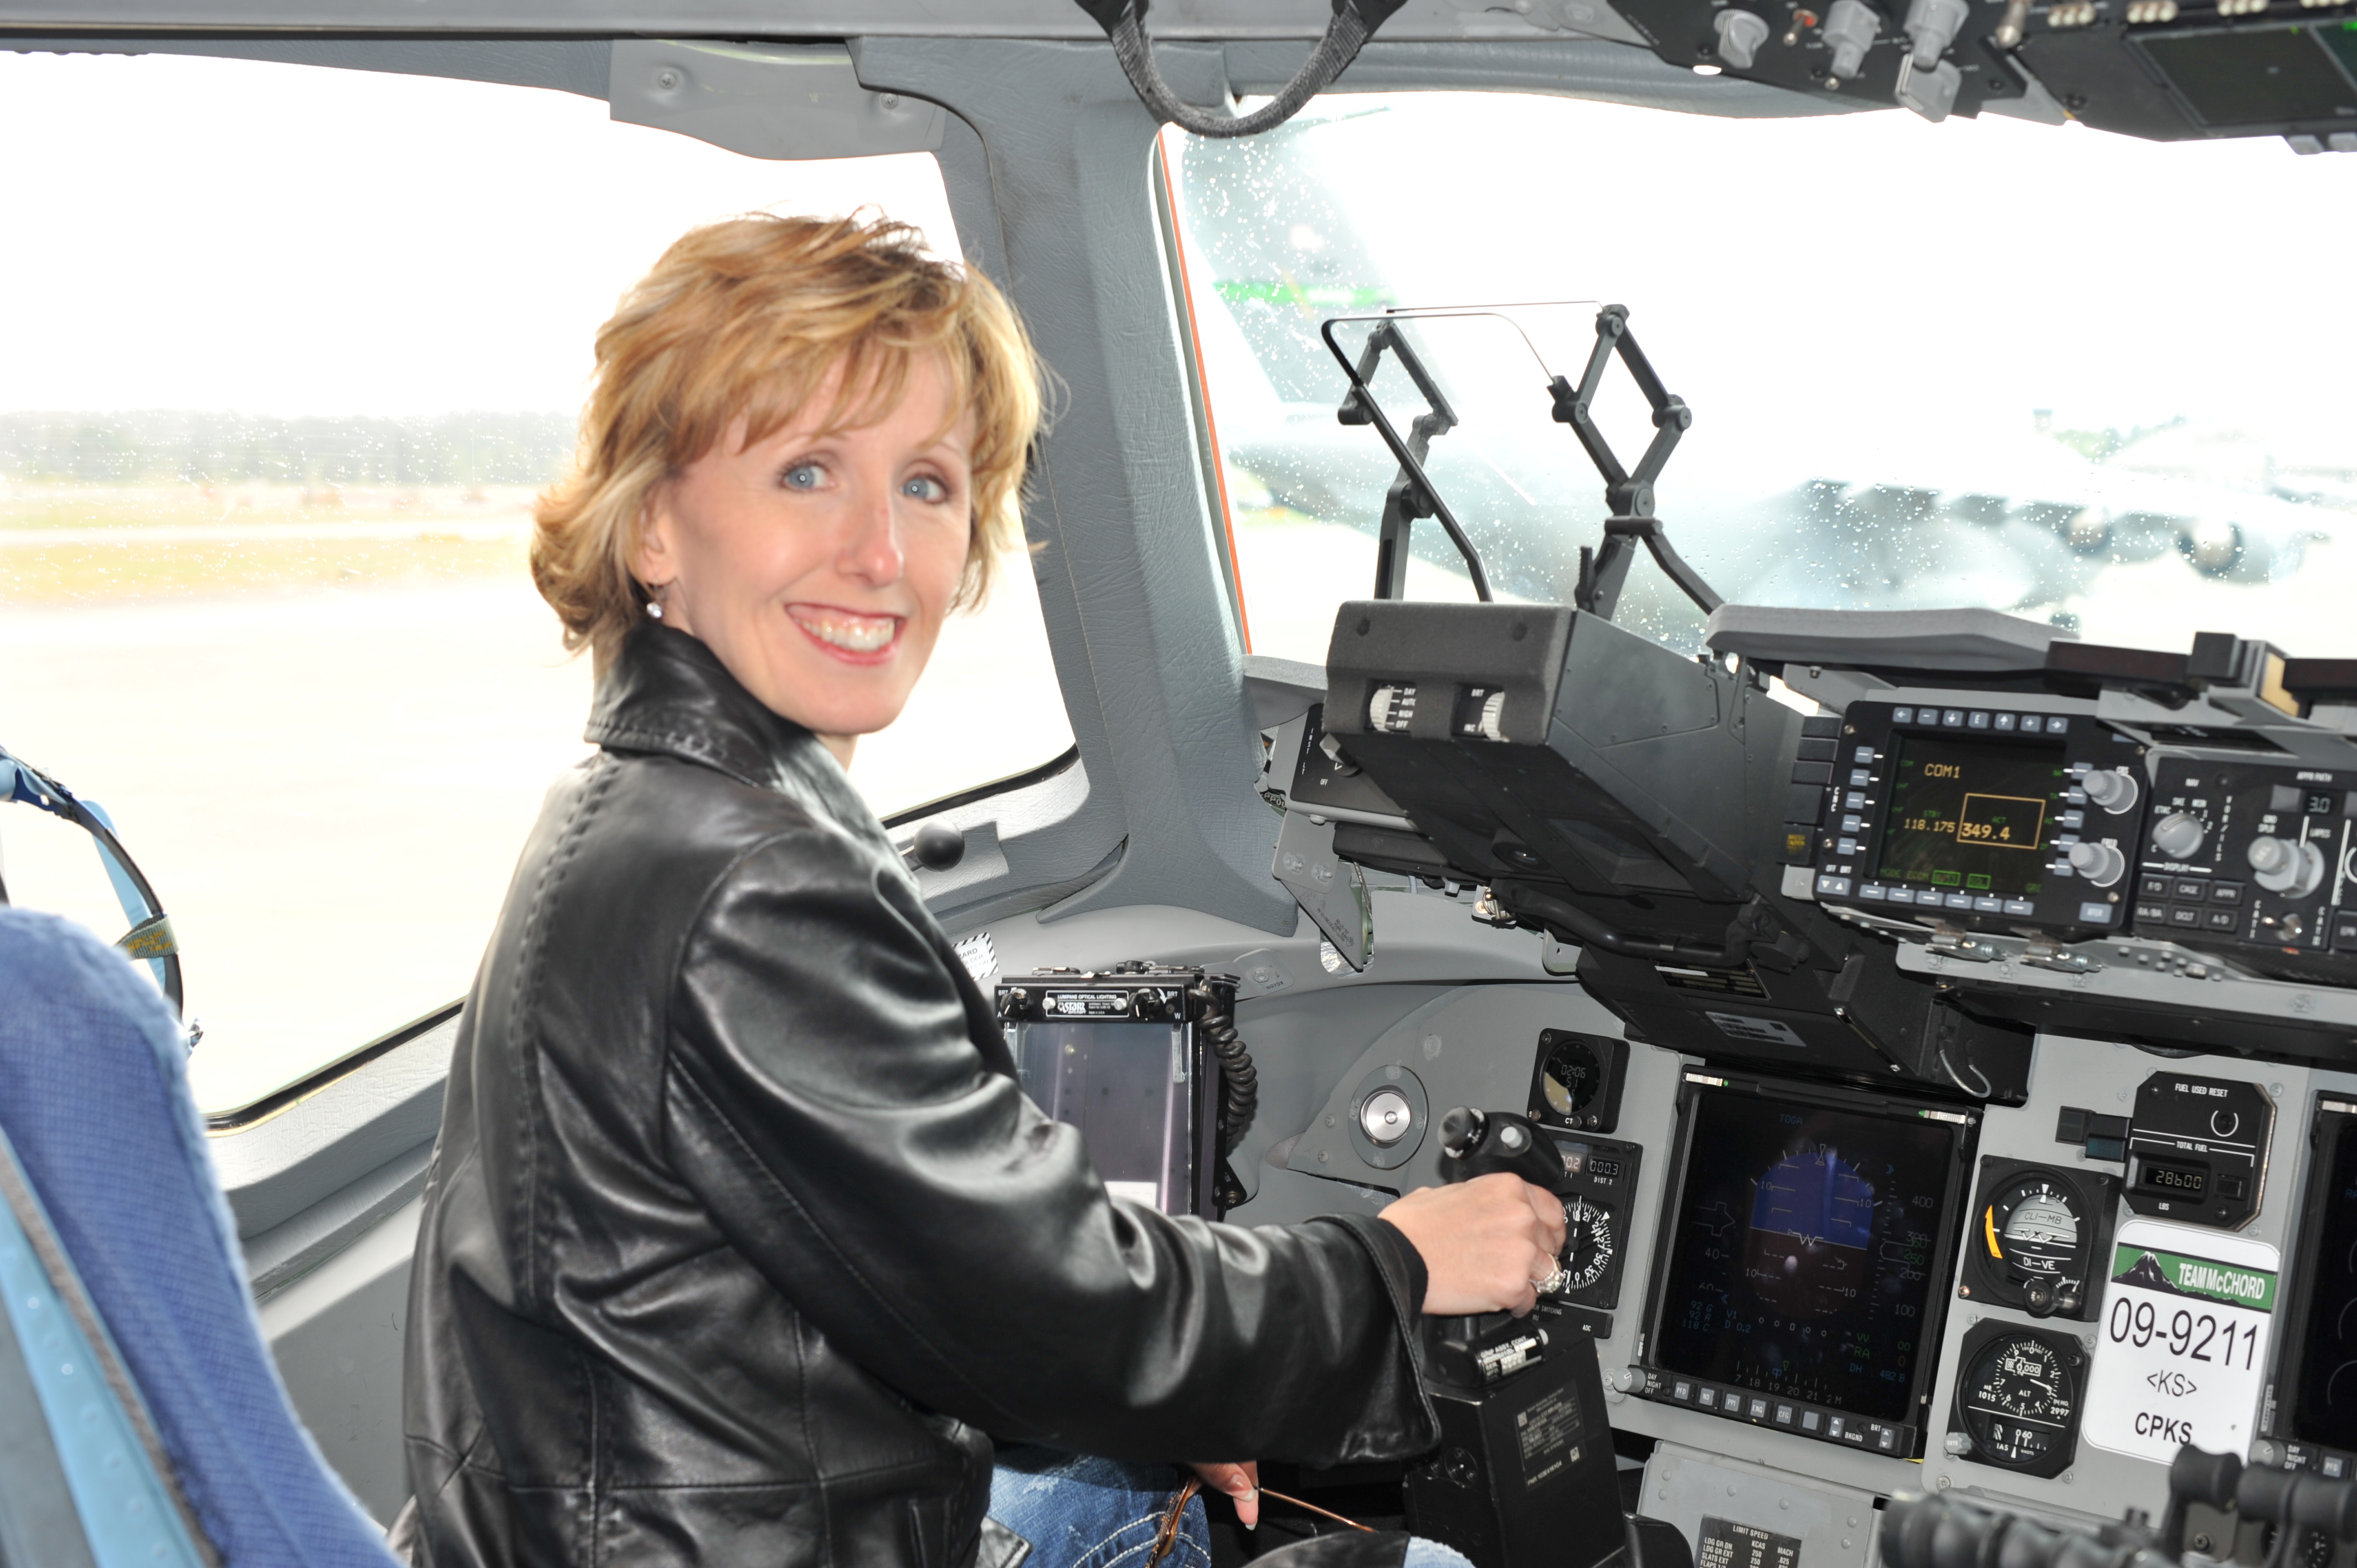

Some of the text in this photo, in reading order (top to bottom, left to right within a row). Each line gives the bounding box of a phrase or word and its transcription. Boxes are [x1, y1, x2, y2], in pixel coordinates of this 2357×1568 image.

[1923, 764, 1960, 779] COM1
[1904, 818, 1956, 833] 118.175
[2206, 821, 2213, 830] 2
[1961, 823, 2010, 840] 349.4
[1561, 1064, 1586, 1079] 02:06
[2175, 1083, 2229, 1097] FUEL USED RESET
[1780, 1113, 1803, 1125] TOGA
[2176, 1141, 2208, 1152] TOTAL FUEL
[1589, 1160, 1619, 1175] 000.3
[1594, 1176, 1607, 1185] DIST
[1761, 1180, 1772, 1190] 10
[1859, 1199, 1872, 1208] 10
[1912, 1195, 1934, 1209] 400
[2158, 1203, 2170, 1211] LBS
[1582, 1211, 1591, 1223] 21
[1903, 1248, 1925, 1266] 250
[1745, 1267, 1758, 1278] 10
[2178, 1262, 2266, 1301] TEAM McCHORD
[1844, 1287, 1856, 1298] 10
[1541, 1306, 1562, 1316] SWITCHING
[1895, 1303, 1916, 1317] 100
[1582, 1324, 1592, 1332] ADC
[2109, 1297, 2259, 1371] 09-9211
[1897, 1340, 1911, 1352] 00
[1854, 1345, 1870, 1360] RA
[1849, 1363, 1862, 1374] DH
[2050, 1370, 2055, 1379] 2
[1646, 1380, 1661, 1390] NIGHT
[2147, 1369, 2198, 1397] <KS>
[1645, 1386, 1654, 1395] OFF
[1676, 1386, 1687, 1395] PFD
[1748, 1377, 1761, 1388] 18
[1768, 1381, 1780, 1392] 19
[1787, 1386, 1800, 1396] 20
[1807, 1390, 1818, 1401] 21
[1702, 1392, 1710, 1401] ND
[1978, 1390, 1996, 1402] 1015
[2006, 1394, 2012, 1402] 6
[1727, 1398, 1736, 1407] PPI
[1752, 1404, 1763, 1414] ENG
[2050, 1407, 2070, 1417] 2997
[1778, 1411, 1789, 1420] CFG
[1870, 1423, 1881, 1432] BRT
[2135, 1412, 2193, 1444] CPKS
[1844, 1431, 1863, 1442] BKGND
[1996, 1442, 2009, 1451] IAS
[1732, 1524, 1768, 1540] LIMIT SPEED
[1704, 1536, 1766, 1550] LDG GR DN KCAS
[1703, 1544, 1794, 1559] LDG GR EXT 250 MACH
[1700, 1559, 1716, 1568] FLAPS
[1701, 1551, 1718, 1562] SLATS
[1718, 1556, 1729, 1565] EXT
[1750, 1557, 1761, 1566] 250
